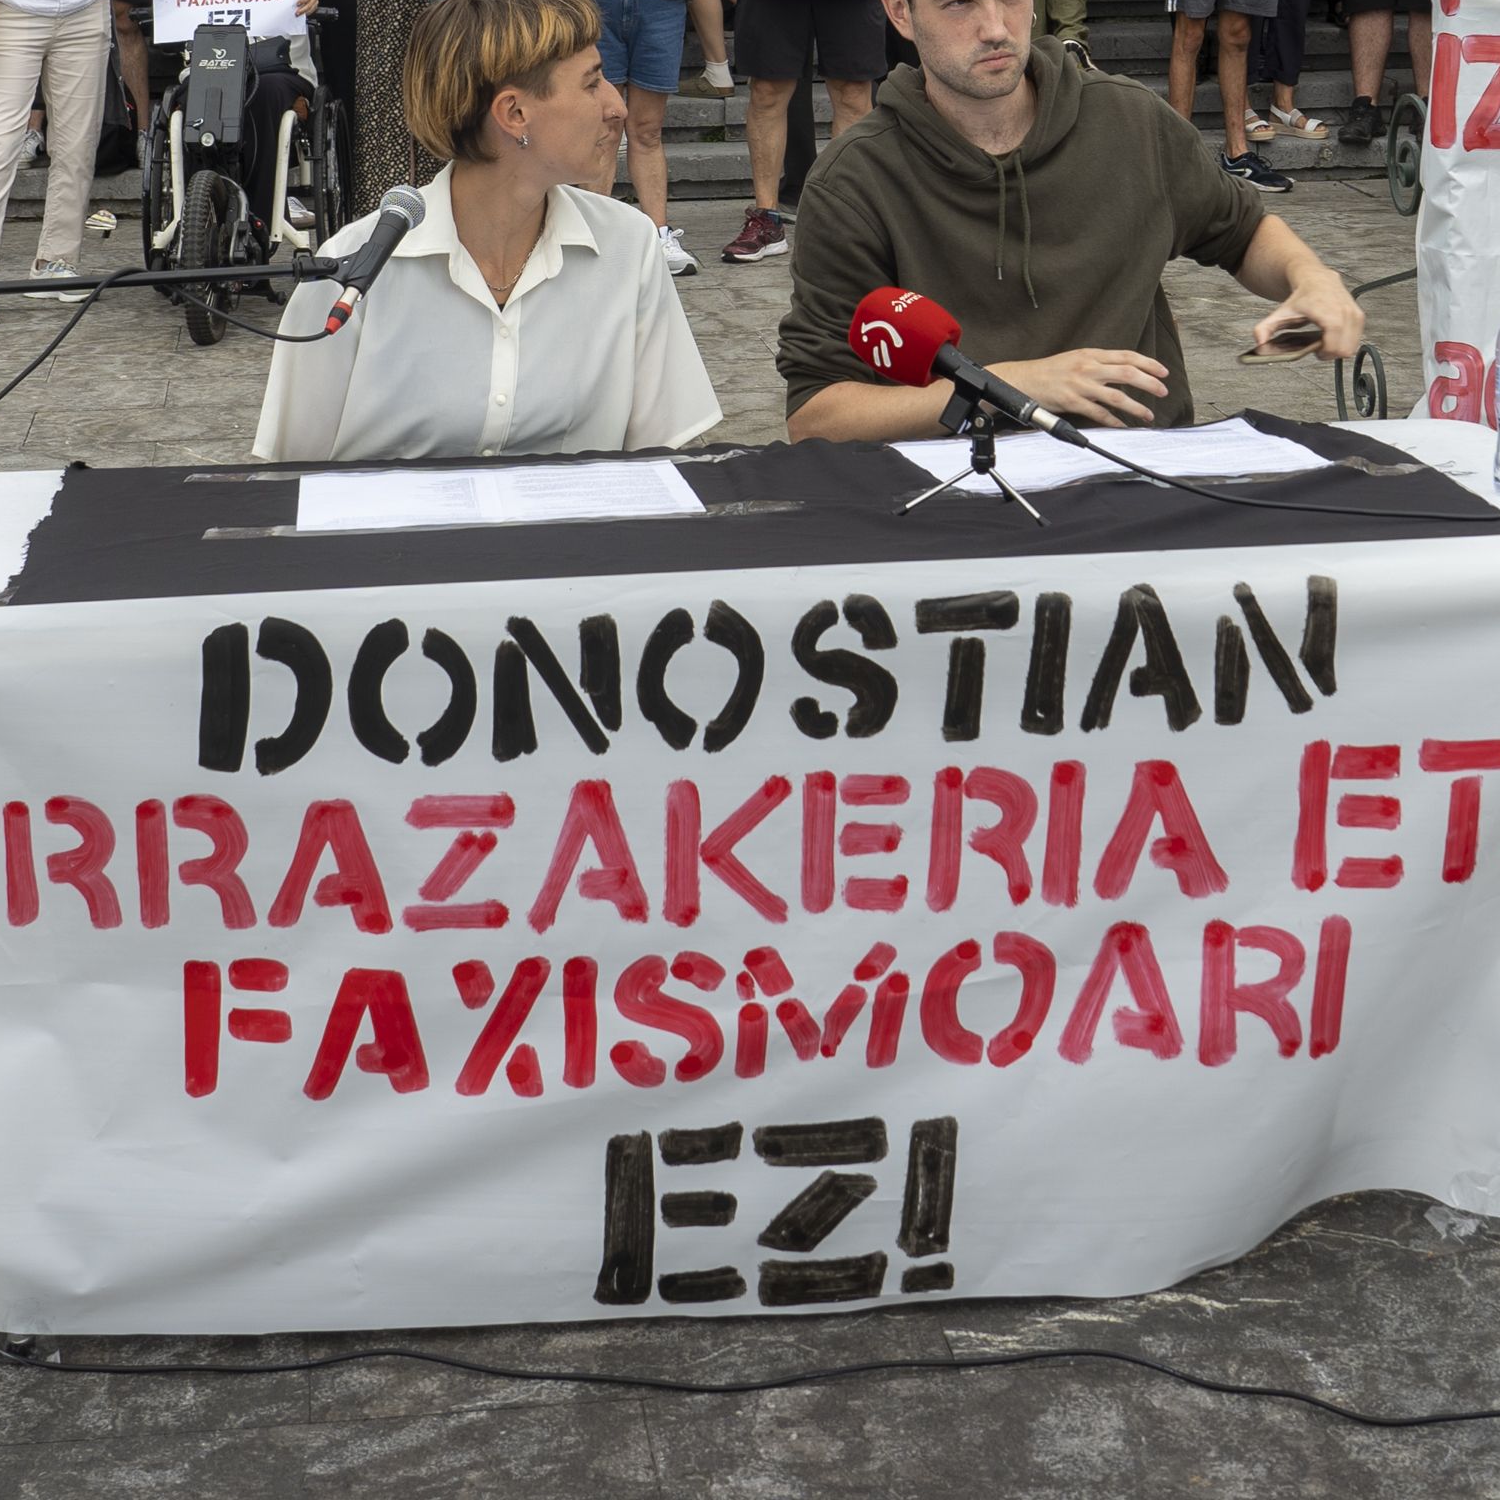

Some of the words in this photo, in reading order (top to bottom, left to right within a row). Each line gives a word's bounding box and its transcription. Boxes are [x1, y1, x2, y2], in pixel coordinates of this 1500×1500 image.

[198, 575, 1338, 776] DONOSTIAN
[184, 914, 1352, 1101] FAXISMOARI
[593, 1116, 958, 1306] EZ!
